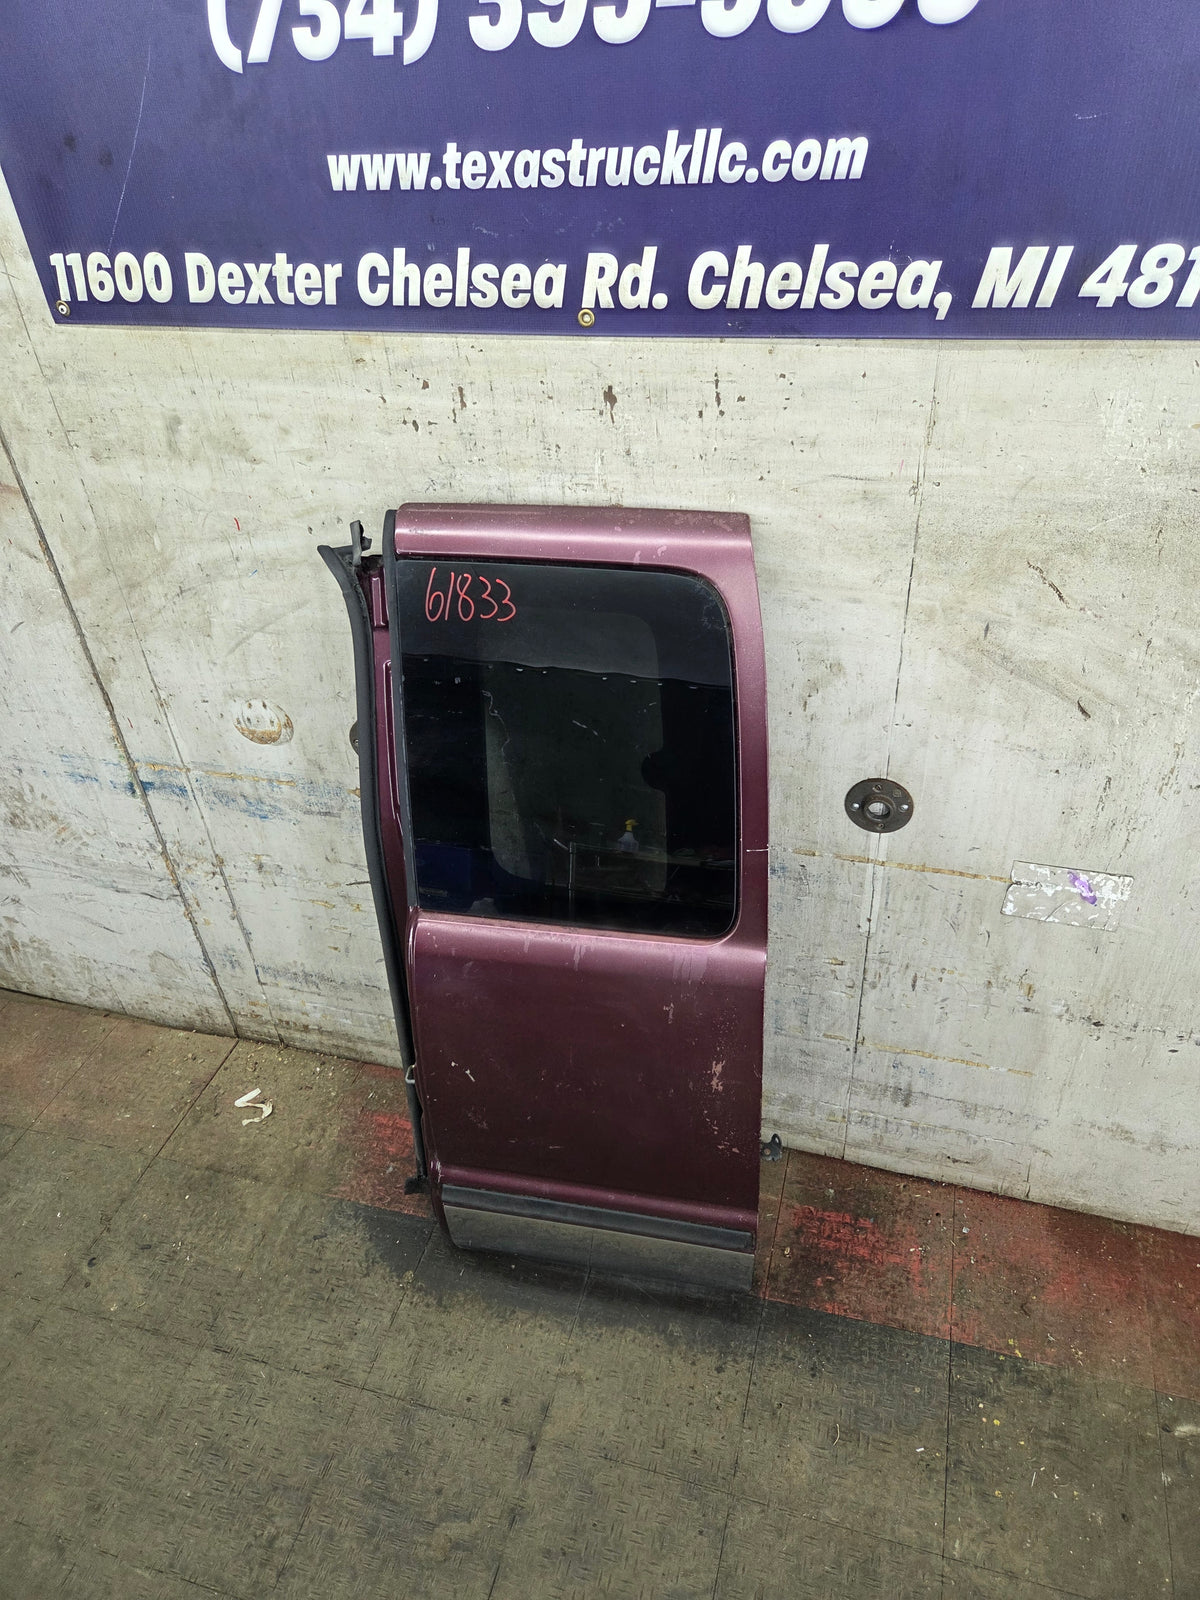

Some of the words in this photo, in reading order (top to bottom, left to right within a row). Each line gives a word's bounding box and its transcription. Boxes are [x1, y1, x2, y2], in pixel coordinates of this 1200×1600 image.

[327, 127, 869, 192] www.texastruckllc.com
[50, 251, 173, 304] 11600
[184, 252, 343, 306] Dexter
[356, 246, 568, 309] Chelsea
[581, 245, 668, 310] Rd.
[687, 243, 953, 321] Chelsea,
[971, 245, 1075, 309] MI
[425, 566, 517, 622] 61833
